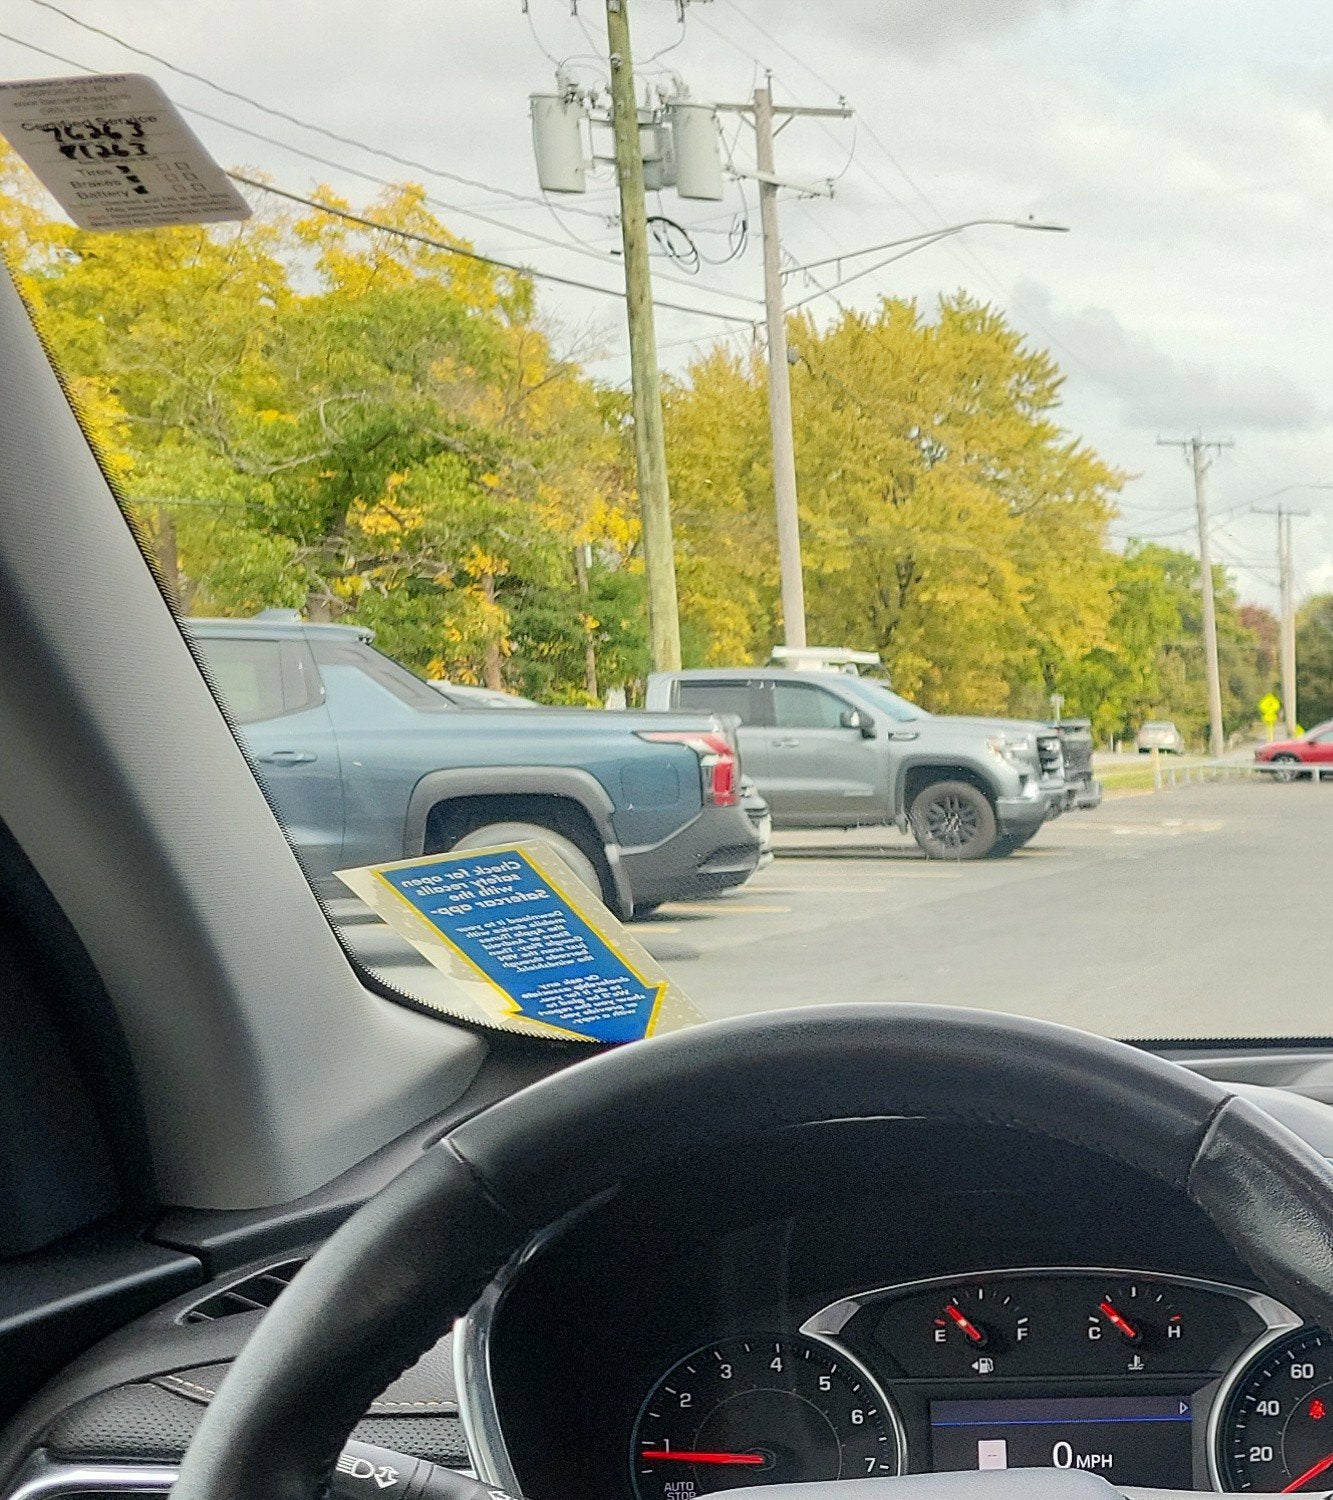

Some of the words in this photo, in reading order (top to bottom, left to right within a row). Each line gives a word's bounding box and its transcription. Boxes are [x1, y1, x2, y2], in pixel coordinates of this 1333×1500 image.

[70, 178, 122, 189] Brakes
[76, 188, 130, 201] Battery
[934, 1329, 947, 1343] E
[1017, 1327, 1028, 1341] F
[1088, 1327, 1101, 1340] C
[1168, 1325, 1181, 1339] H
[720, 1364, 732, 1379] 3
[770, 1357, 783, 1372] 4
[1290, 1363, 1315, 1379] 60
[819, 1376, 831, 1391] 5
[680, 1393, 692, 1408] 2
[1256, 1400, 1280, 1416] 40
[851, 1410, 864, 1425] 6
[663, 1439, 671, 1454] 1
[1249, 1446, 1273, 1462] 20
[1052, 1441, 1074, 1469] 0
[1076, 1454, 1113, 1469] MPH
[864, 1457, 877, 1473] 7
[664, 1481, 694, 1492] AUTO
[667, 1491, 696, 1500] STOP
